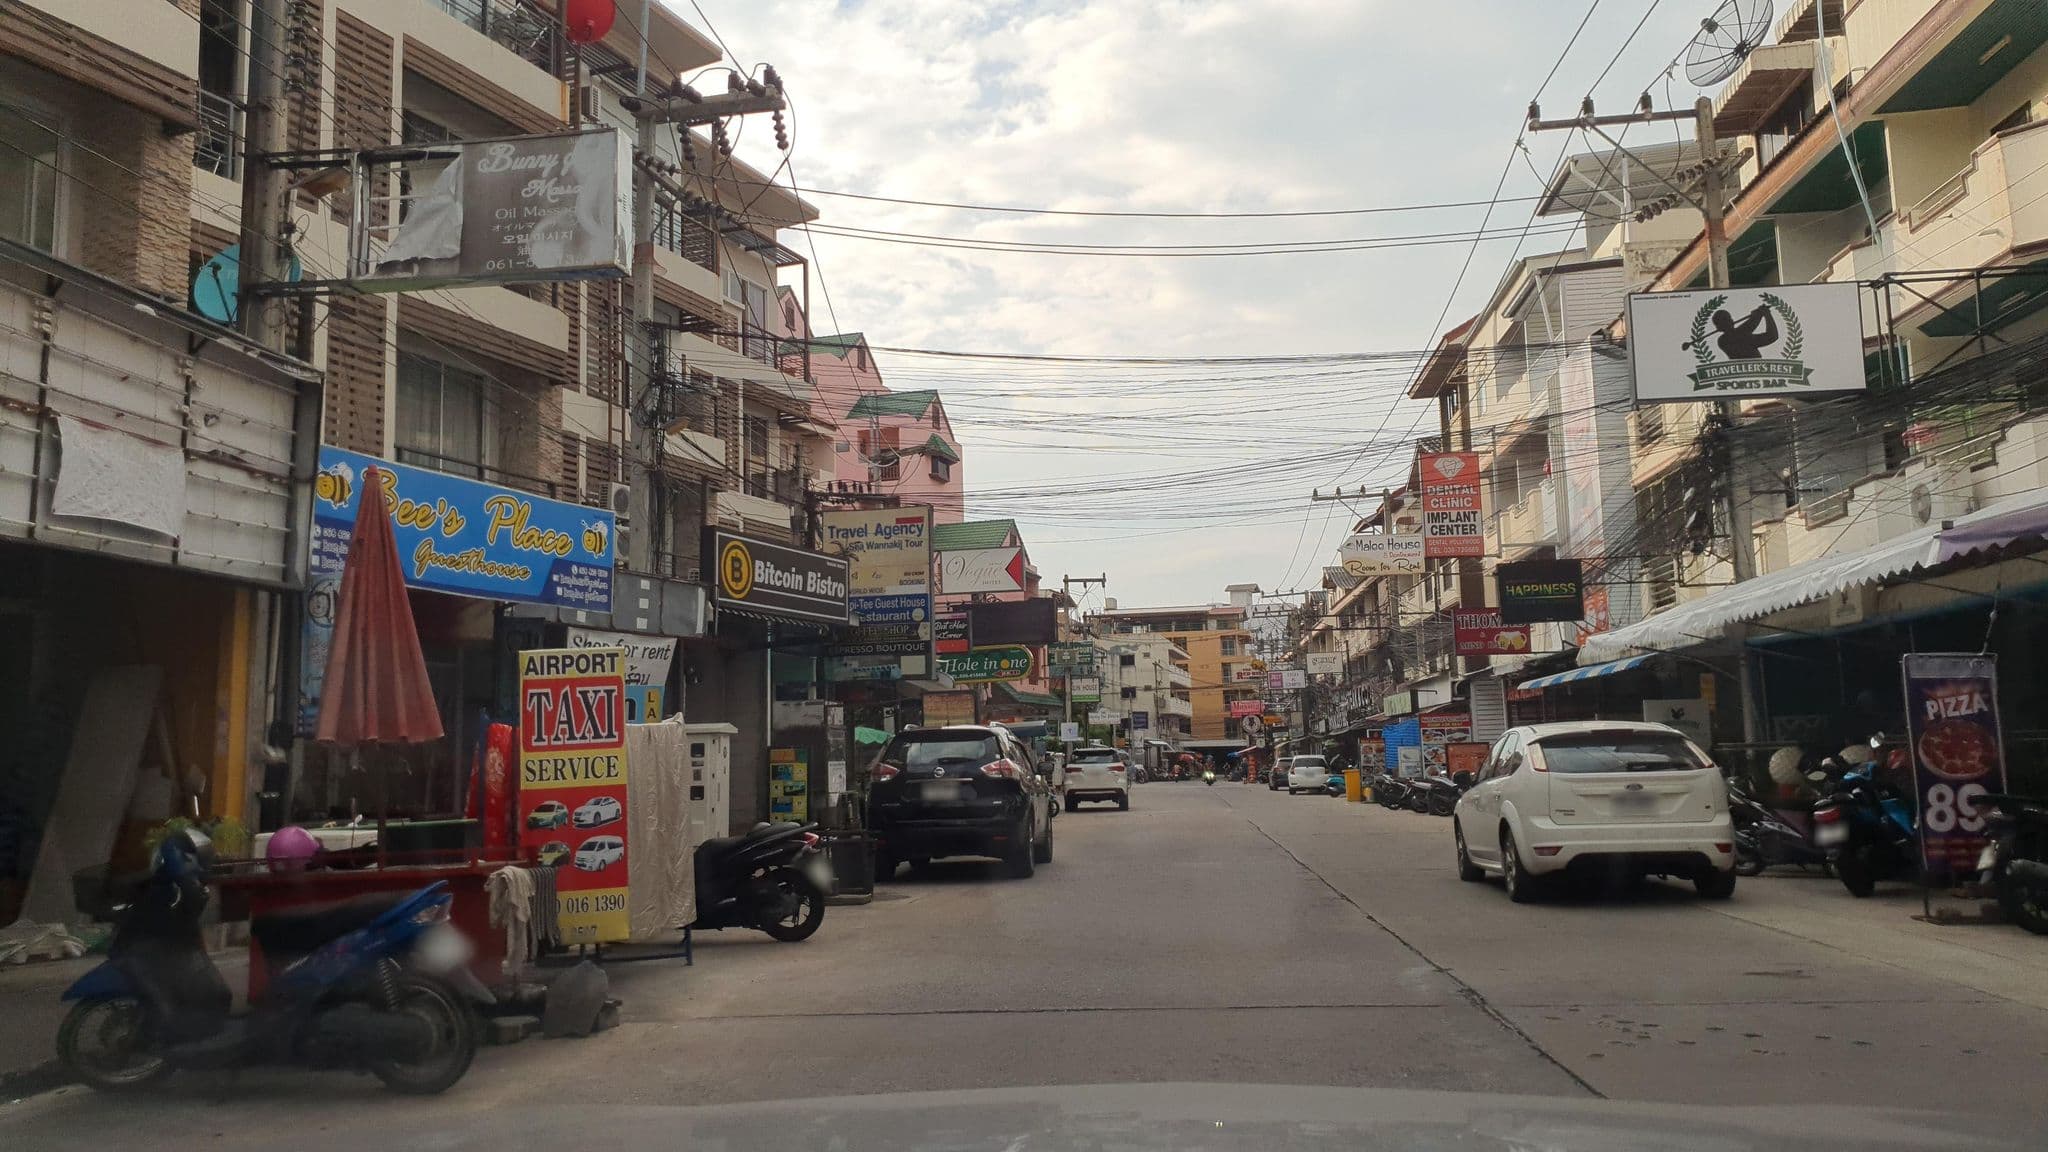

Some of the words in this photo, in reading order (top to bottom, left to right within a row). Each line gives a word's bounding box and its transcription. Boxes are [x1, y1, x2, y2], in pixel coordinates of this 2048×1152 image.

[478, 143, 558, 178] Bunny
[521, 177, 585, 203] Massa
[495, 207, 517, 220] Oil
[524, 205, 577, 217] Massag
[1705, 363, 1768, 377] TRAVELLER'S
[1770, 363, 1794, 374] REST
[1716, 380, 1761, 391] SPORTS
[1763, 378, 1788, 389] BAR
[1426, 484, 1478, 495] DENTAL
[1430, 497, 1473, 508] CLINIC
[362, 467, 466, 538] Bee's
[485, 495, 574, 557] Place
[1427, 511, 1478, 524] IMPLANT
[827, 523, 868, 540] Travel
[874, 522, 924, 540] Agency
[1430, 524, 1477, 536] CENTER
[905, 539, 924, 549] Tour
[1387, 538, 1421, 550] House
[414, 538, 532, 580] Guesthouse
[754, 559, 803, 591] Bitcoin
[807, 571, 846, 599] Bistro
[1505, 582, 1577, 596] HAPPINESS
[875, 598, 899, 609] Guest
[900, 597, 926, 607] House
[861, 611, 911, 622] estaurant
[641, 645, 671, 660] rent
[876, 643, 926, 652] BOUTIQUE
[524, 652, 619, 676] AIRPORT
[984, 658, 998, 670] in
[1925, 693, 1989, 721] PIZZA
[526, 684, 619, 747] TAXI
[525, 755, 619, 783] SERVICE
[566, 896, 589, 914] 016
[594, 893, 625, 912] 1390
